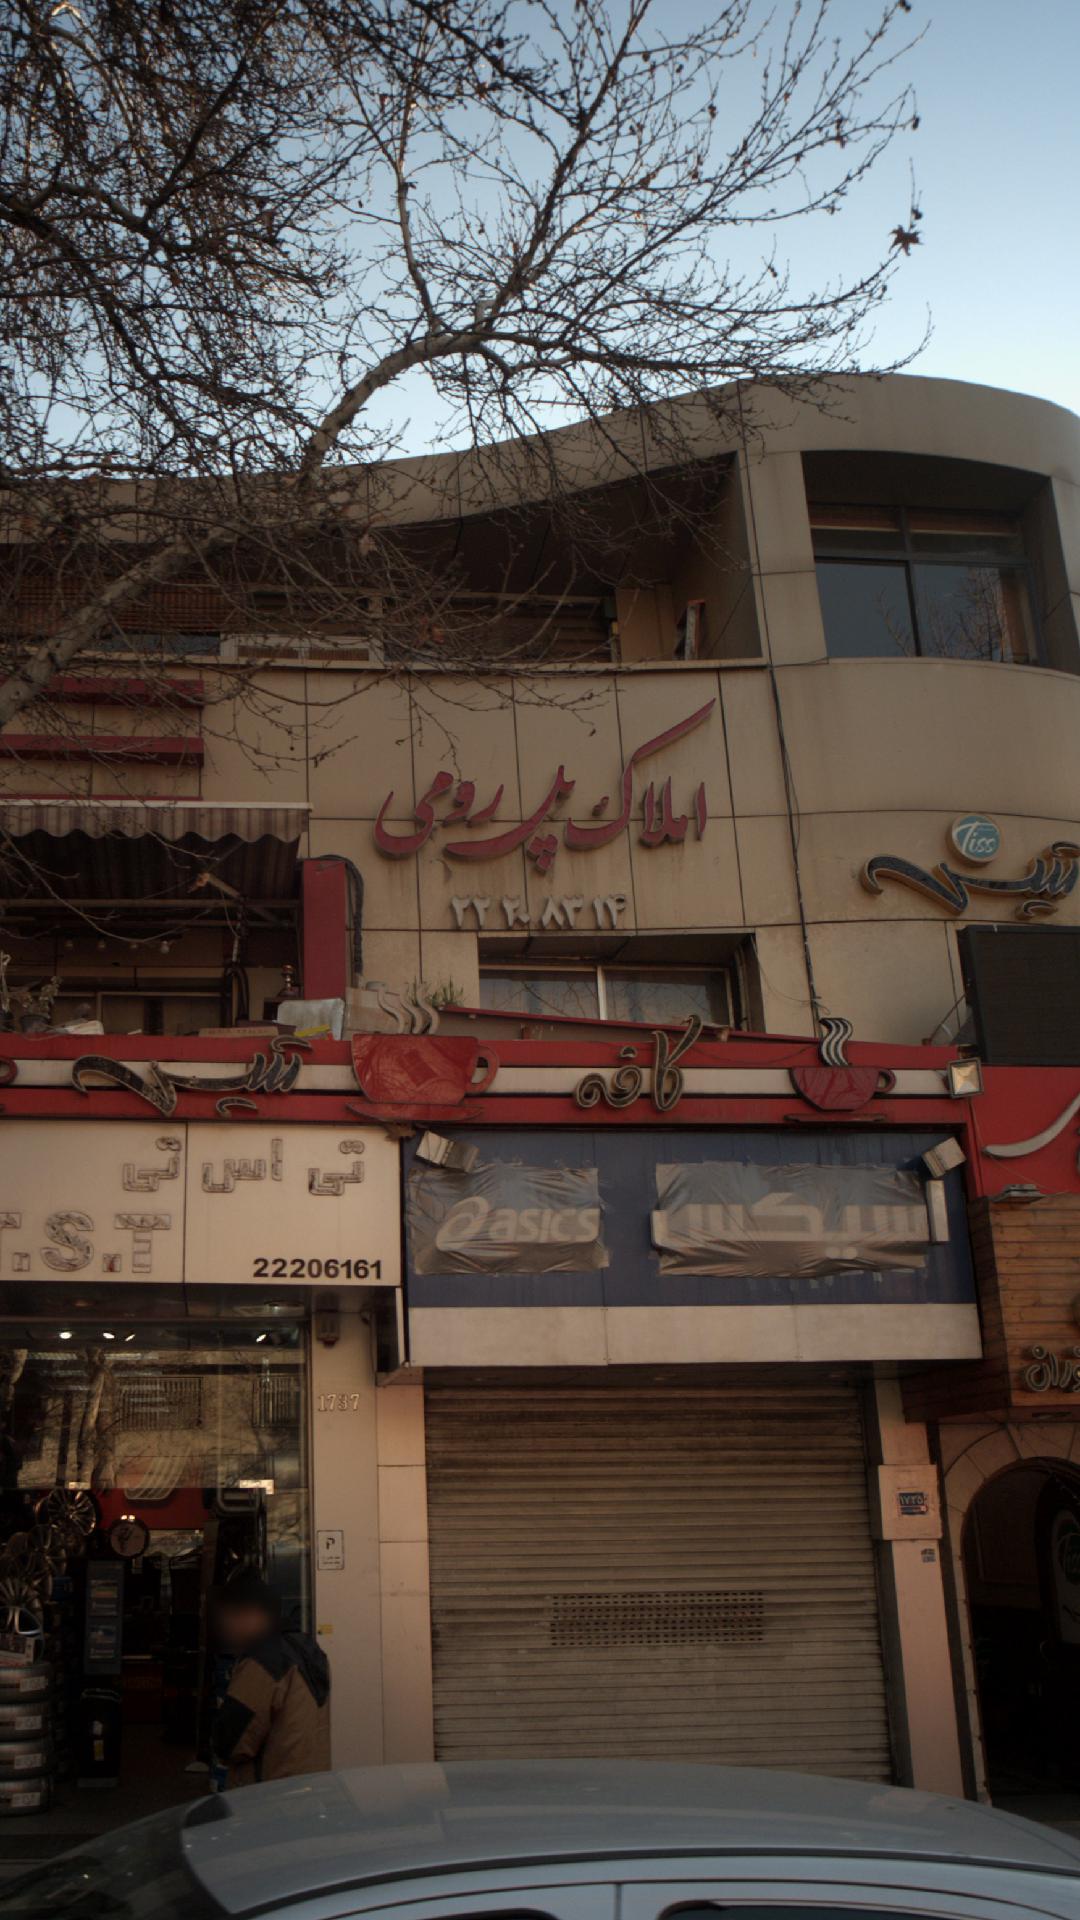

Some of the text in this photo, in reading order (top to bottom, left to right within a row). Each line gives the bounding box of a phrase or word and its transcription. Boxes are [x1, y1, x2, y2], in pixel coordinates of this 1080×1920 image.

[374, 698, 716, 873] املاک پل رومی
[956, 821, 997, 853] Tiss
[576, 1015, 703, 1111] کافه
[122, 1136, 365, 1195] تی اس تی
[253, 1258, 382, 1279] 22206161
[318, 1393, 360, 1411] 1737
